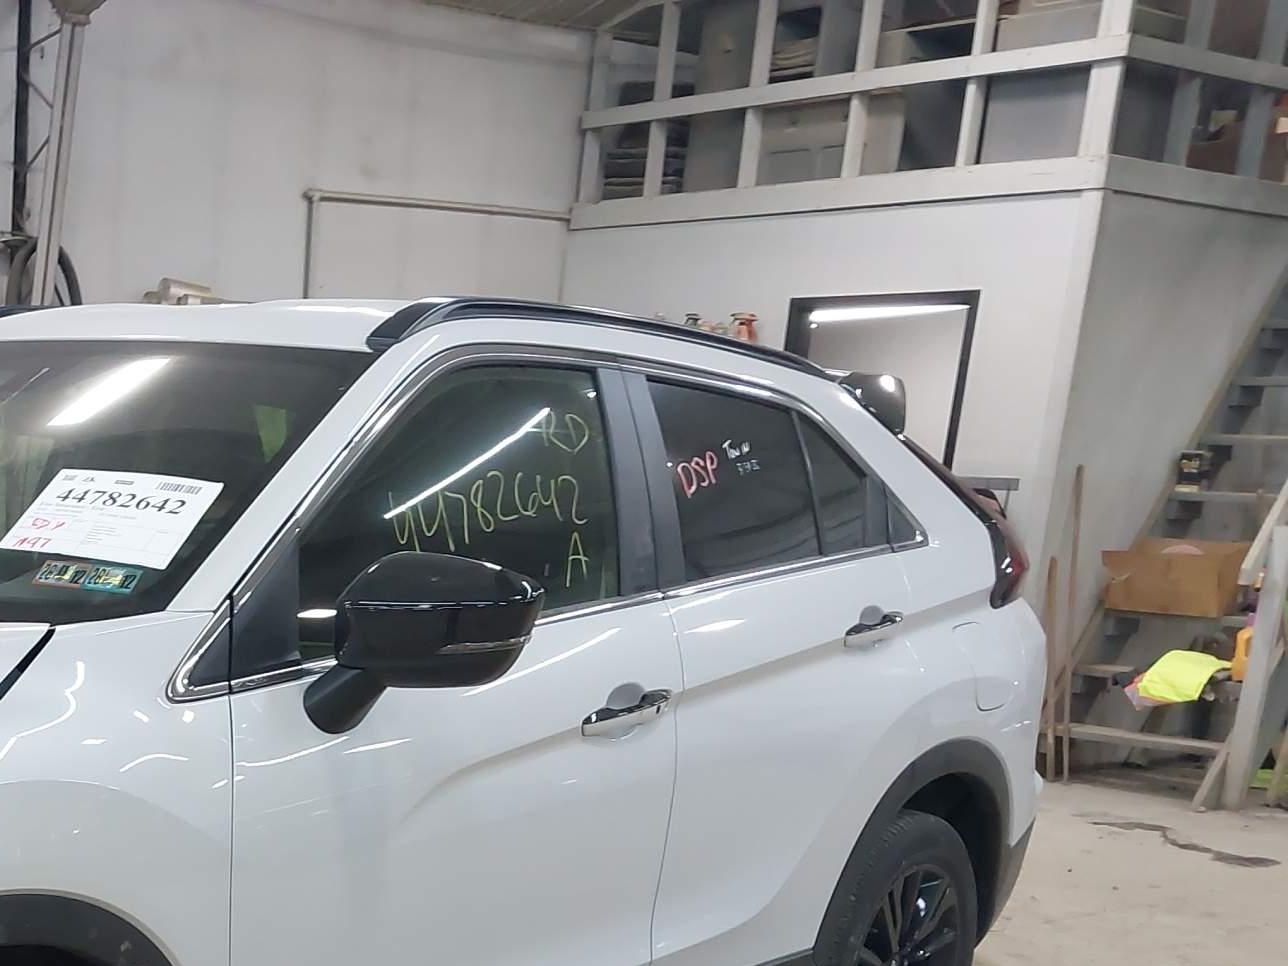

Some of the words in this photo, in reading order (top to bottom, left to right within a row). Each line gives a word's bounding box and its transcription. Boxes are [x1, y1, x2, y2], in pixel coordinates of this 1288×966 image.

[677, 451, 719, 498] DSP
[56, 487, 187, 515] 44782642
[388, 470, 589, 552] 44782642
[566, 532, 589, 587] A
